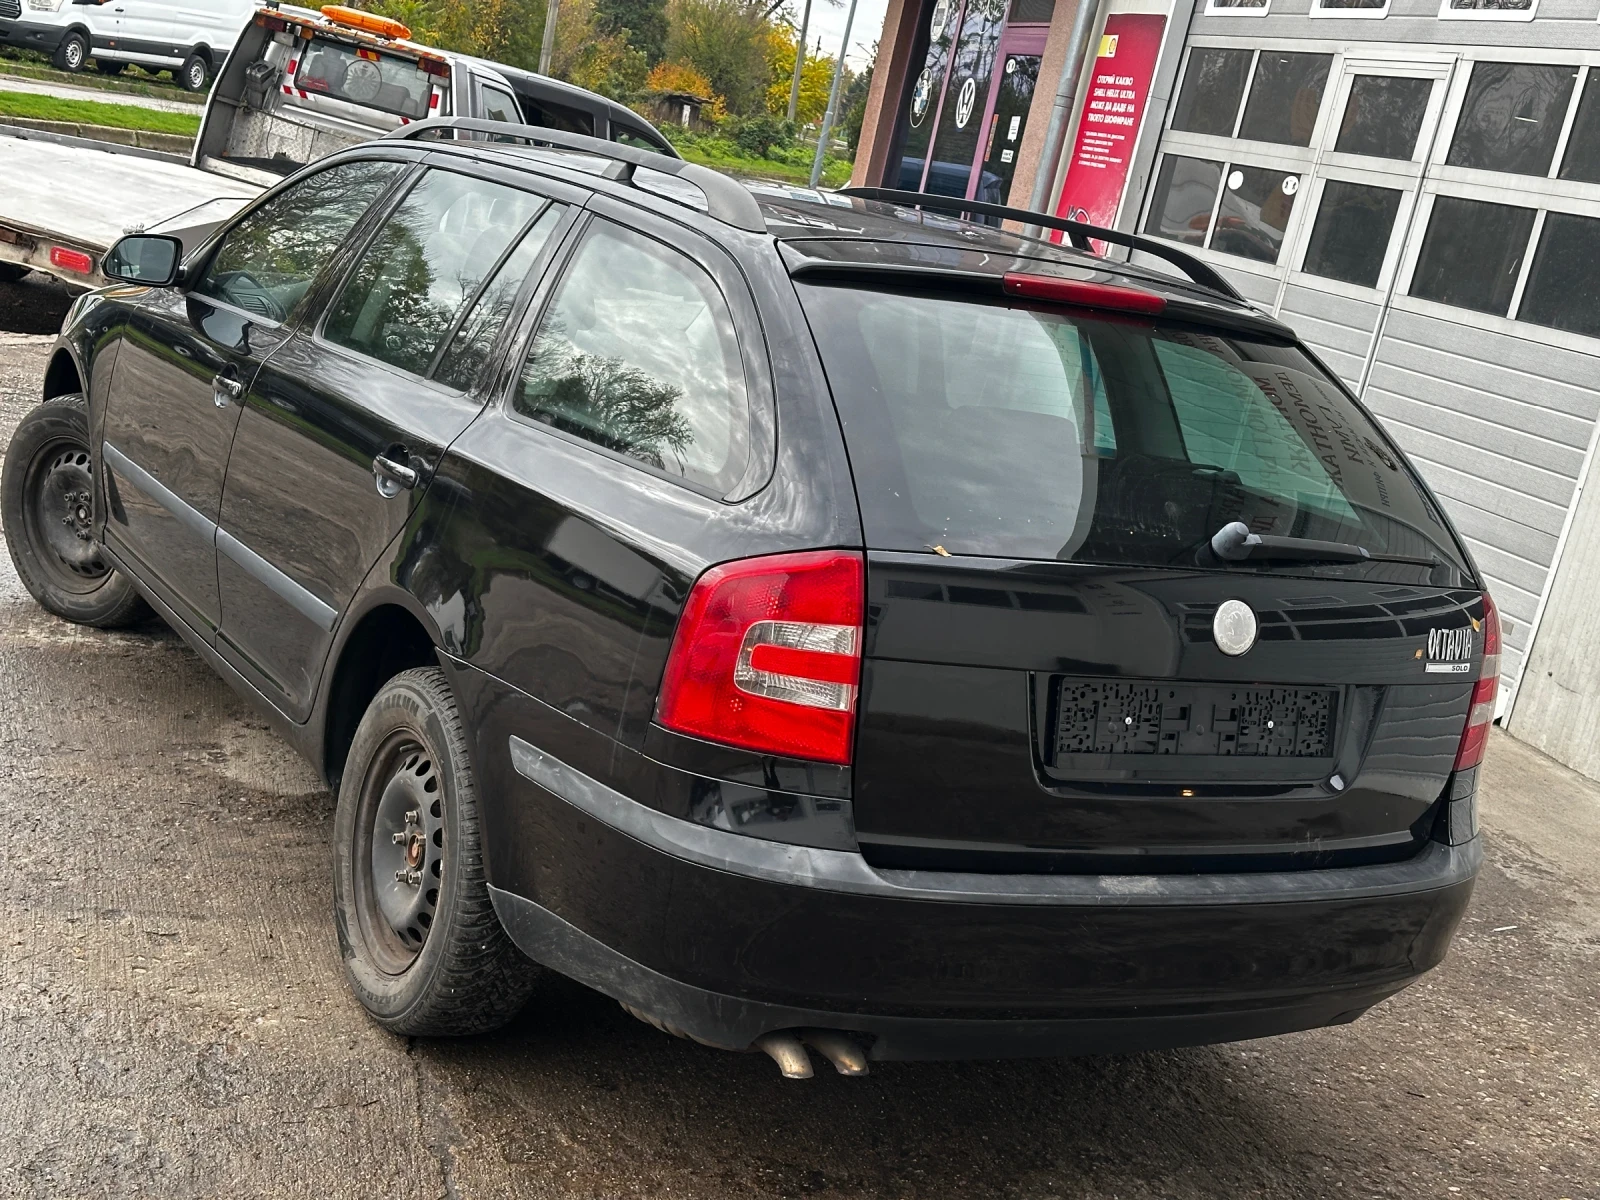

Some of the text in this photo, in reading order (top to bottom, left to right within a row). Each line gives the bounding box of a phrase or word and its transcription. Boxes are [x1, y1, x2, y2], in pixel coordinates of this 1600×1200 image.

[1097, 74, 1133, 86] ОТКРИЙ КАКВО
[1094, 88, 1135, 99] SHELL HELIX ULTRA
[1090, 100, 1135, 113] МОЖЕ ДА ДАДЕ НА
[1087, 113, 1134, 126] ТВОЕТО ШОФИРАНЕ
[1427, 628, 1472, 661] OCTAVIA
